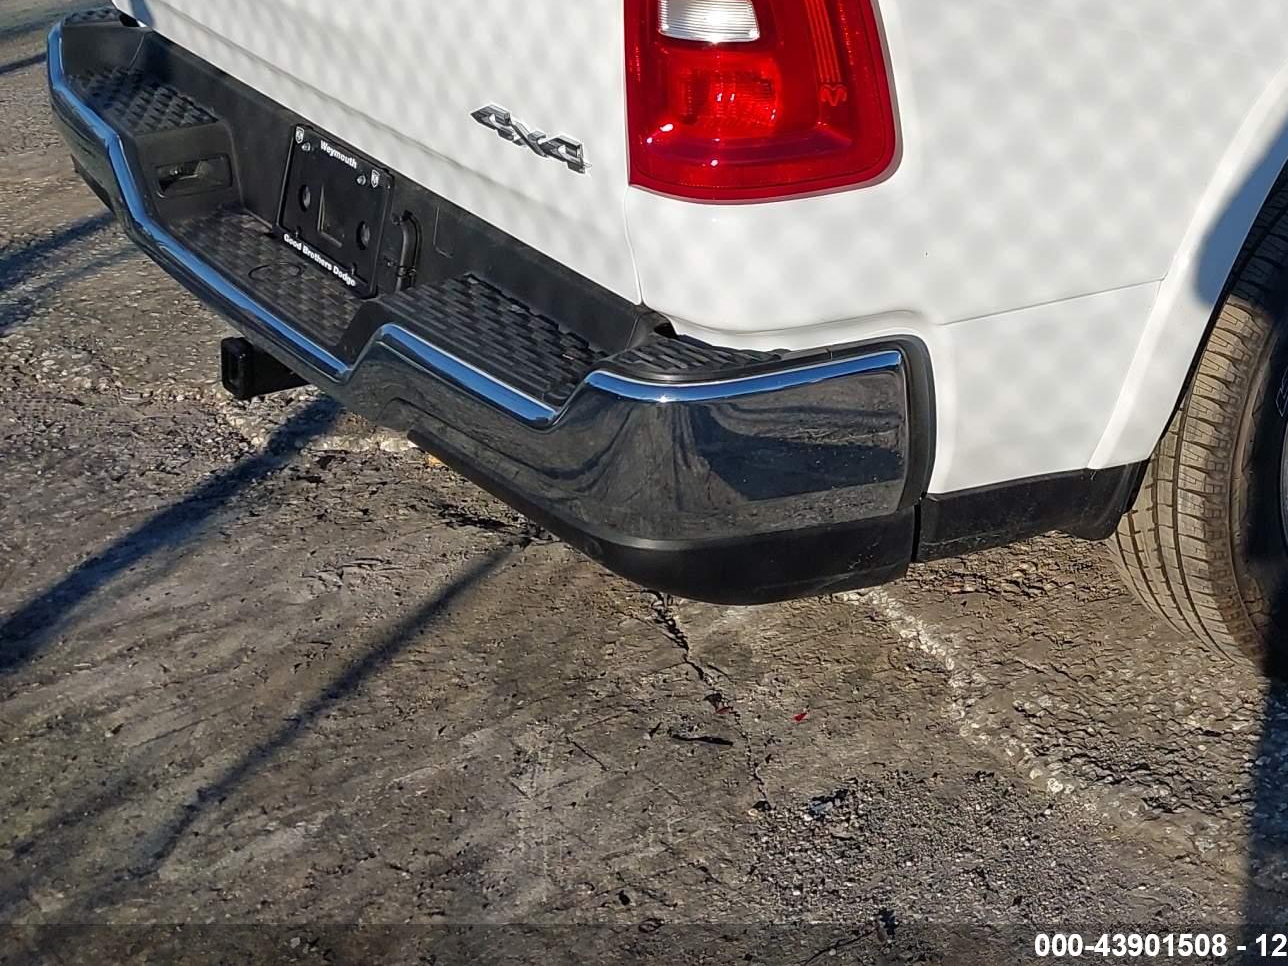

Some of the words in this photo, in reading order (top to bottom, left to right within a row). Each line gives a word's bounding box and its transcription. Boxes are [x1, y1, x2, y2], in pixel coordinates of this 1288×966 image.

[320, 140, 357, 169] Weymouth
[283, 234, 302, 251] Good
[302, 245, 333, 272] Brothers
[332, 265, 357, 287] Dodge
